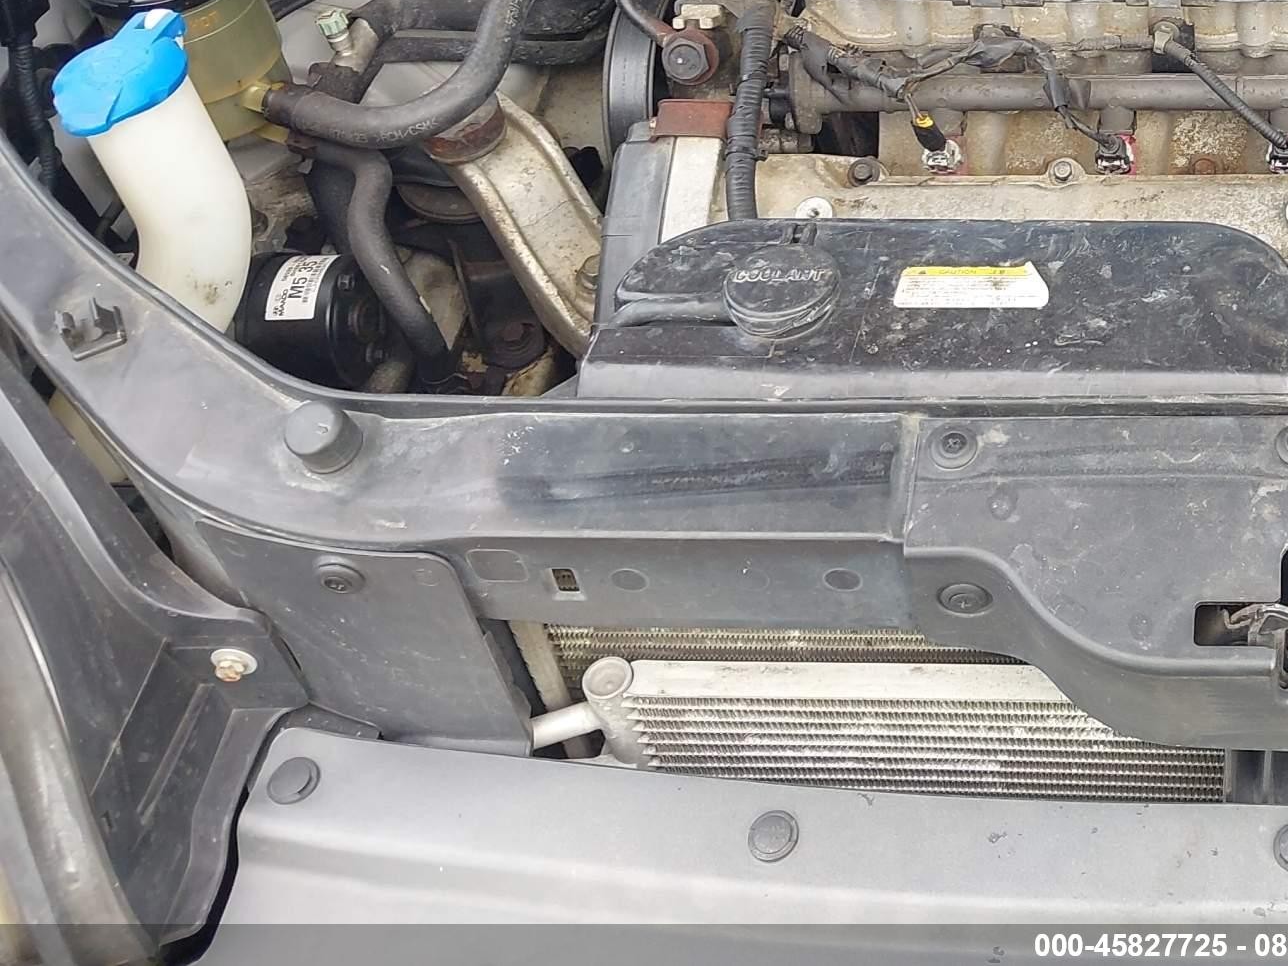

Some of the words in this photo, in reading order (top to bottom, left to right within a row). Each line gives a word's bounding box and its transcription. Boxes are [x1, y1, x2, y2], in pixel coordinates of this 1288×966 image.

[298, 260, 318, 273] 35
[732, 267, 833, 283] COOLANT
[288, 277, 308, 299] M5
[278, 288, 289, 317] MANDO
